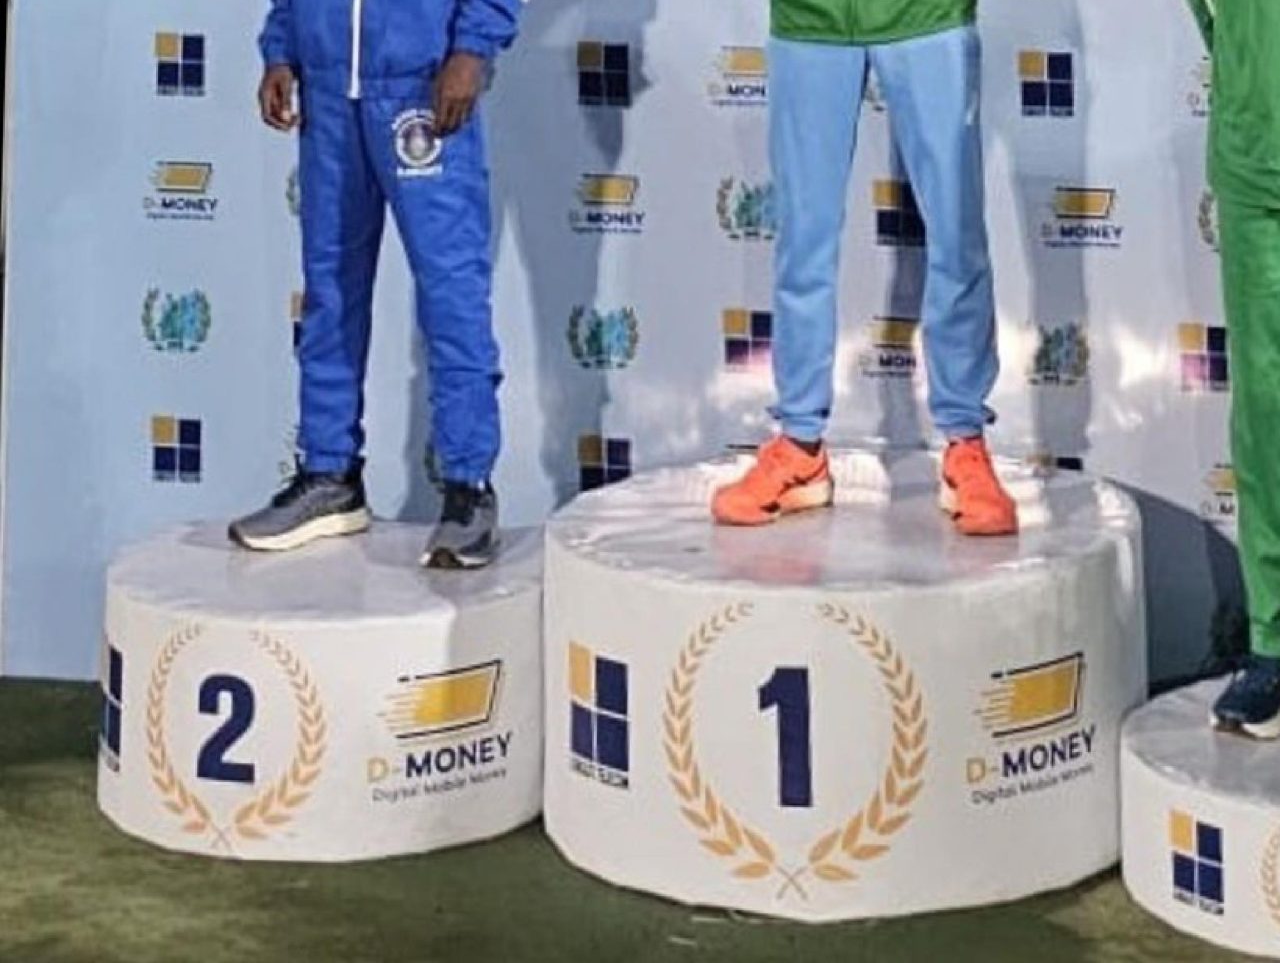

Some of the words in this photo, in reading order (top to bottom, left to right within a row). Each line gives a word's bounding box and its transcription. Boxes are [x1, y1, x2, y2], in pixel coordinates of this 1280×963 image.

[195, 672, 257, 784] 2
[367, 729, 512, 784] D-MONEY
[757, 665, 813, 808] 1
[965, 723, 1096, 785] D-MONEY
